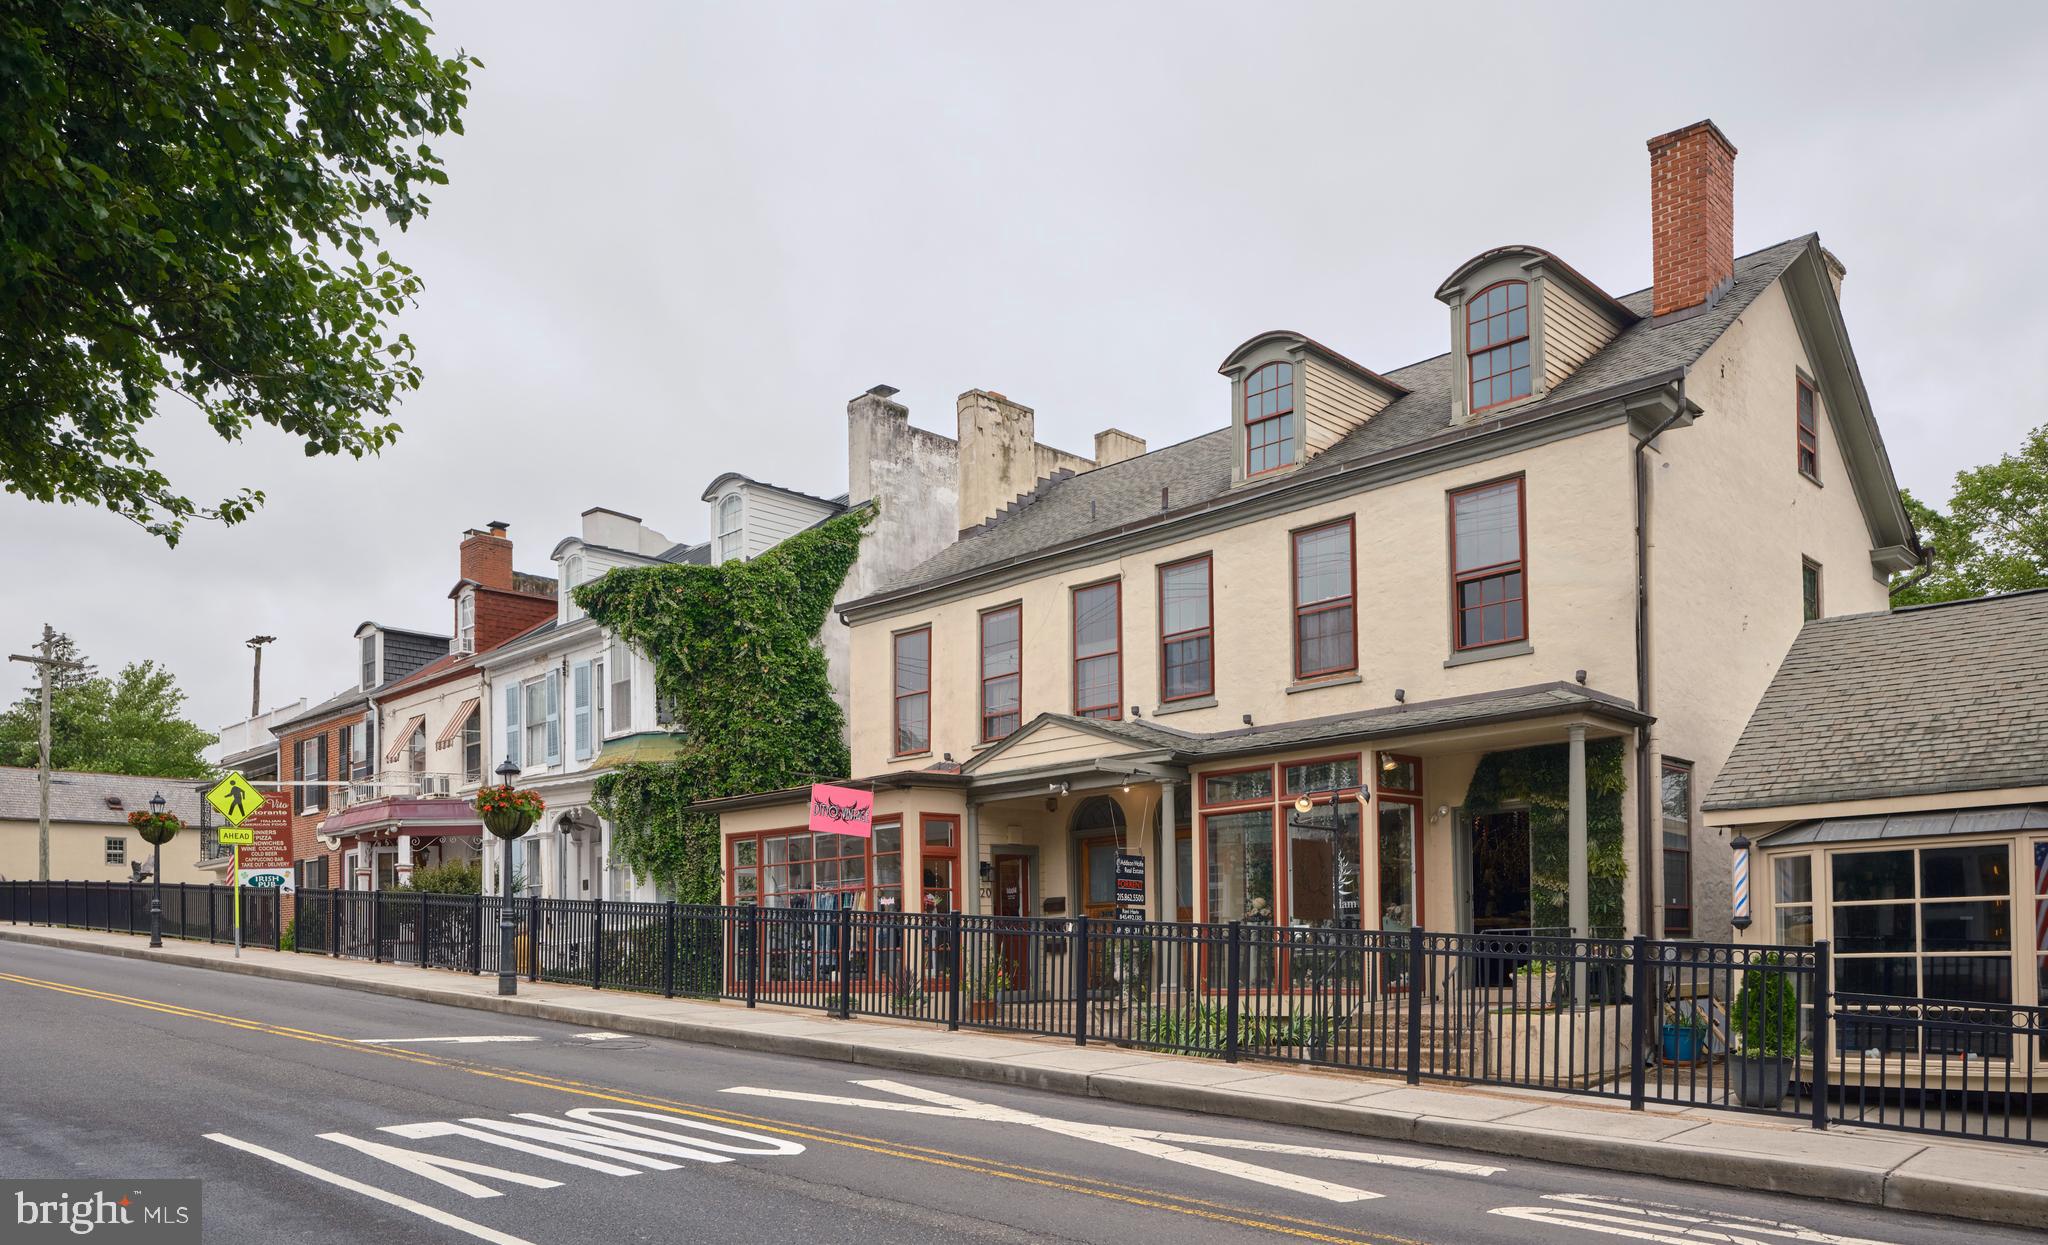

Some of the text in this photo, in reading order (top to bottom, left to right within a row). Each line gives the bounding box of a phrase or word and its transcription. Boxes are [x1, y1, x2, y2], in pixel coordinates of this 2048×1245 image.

[266, 799, 288, 809] Vito
[980, 888, 992, 898] 20
[315, 1107, 806, 1199] ONLY
